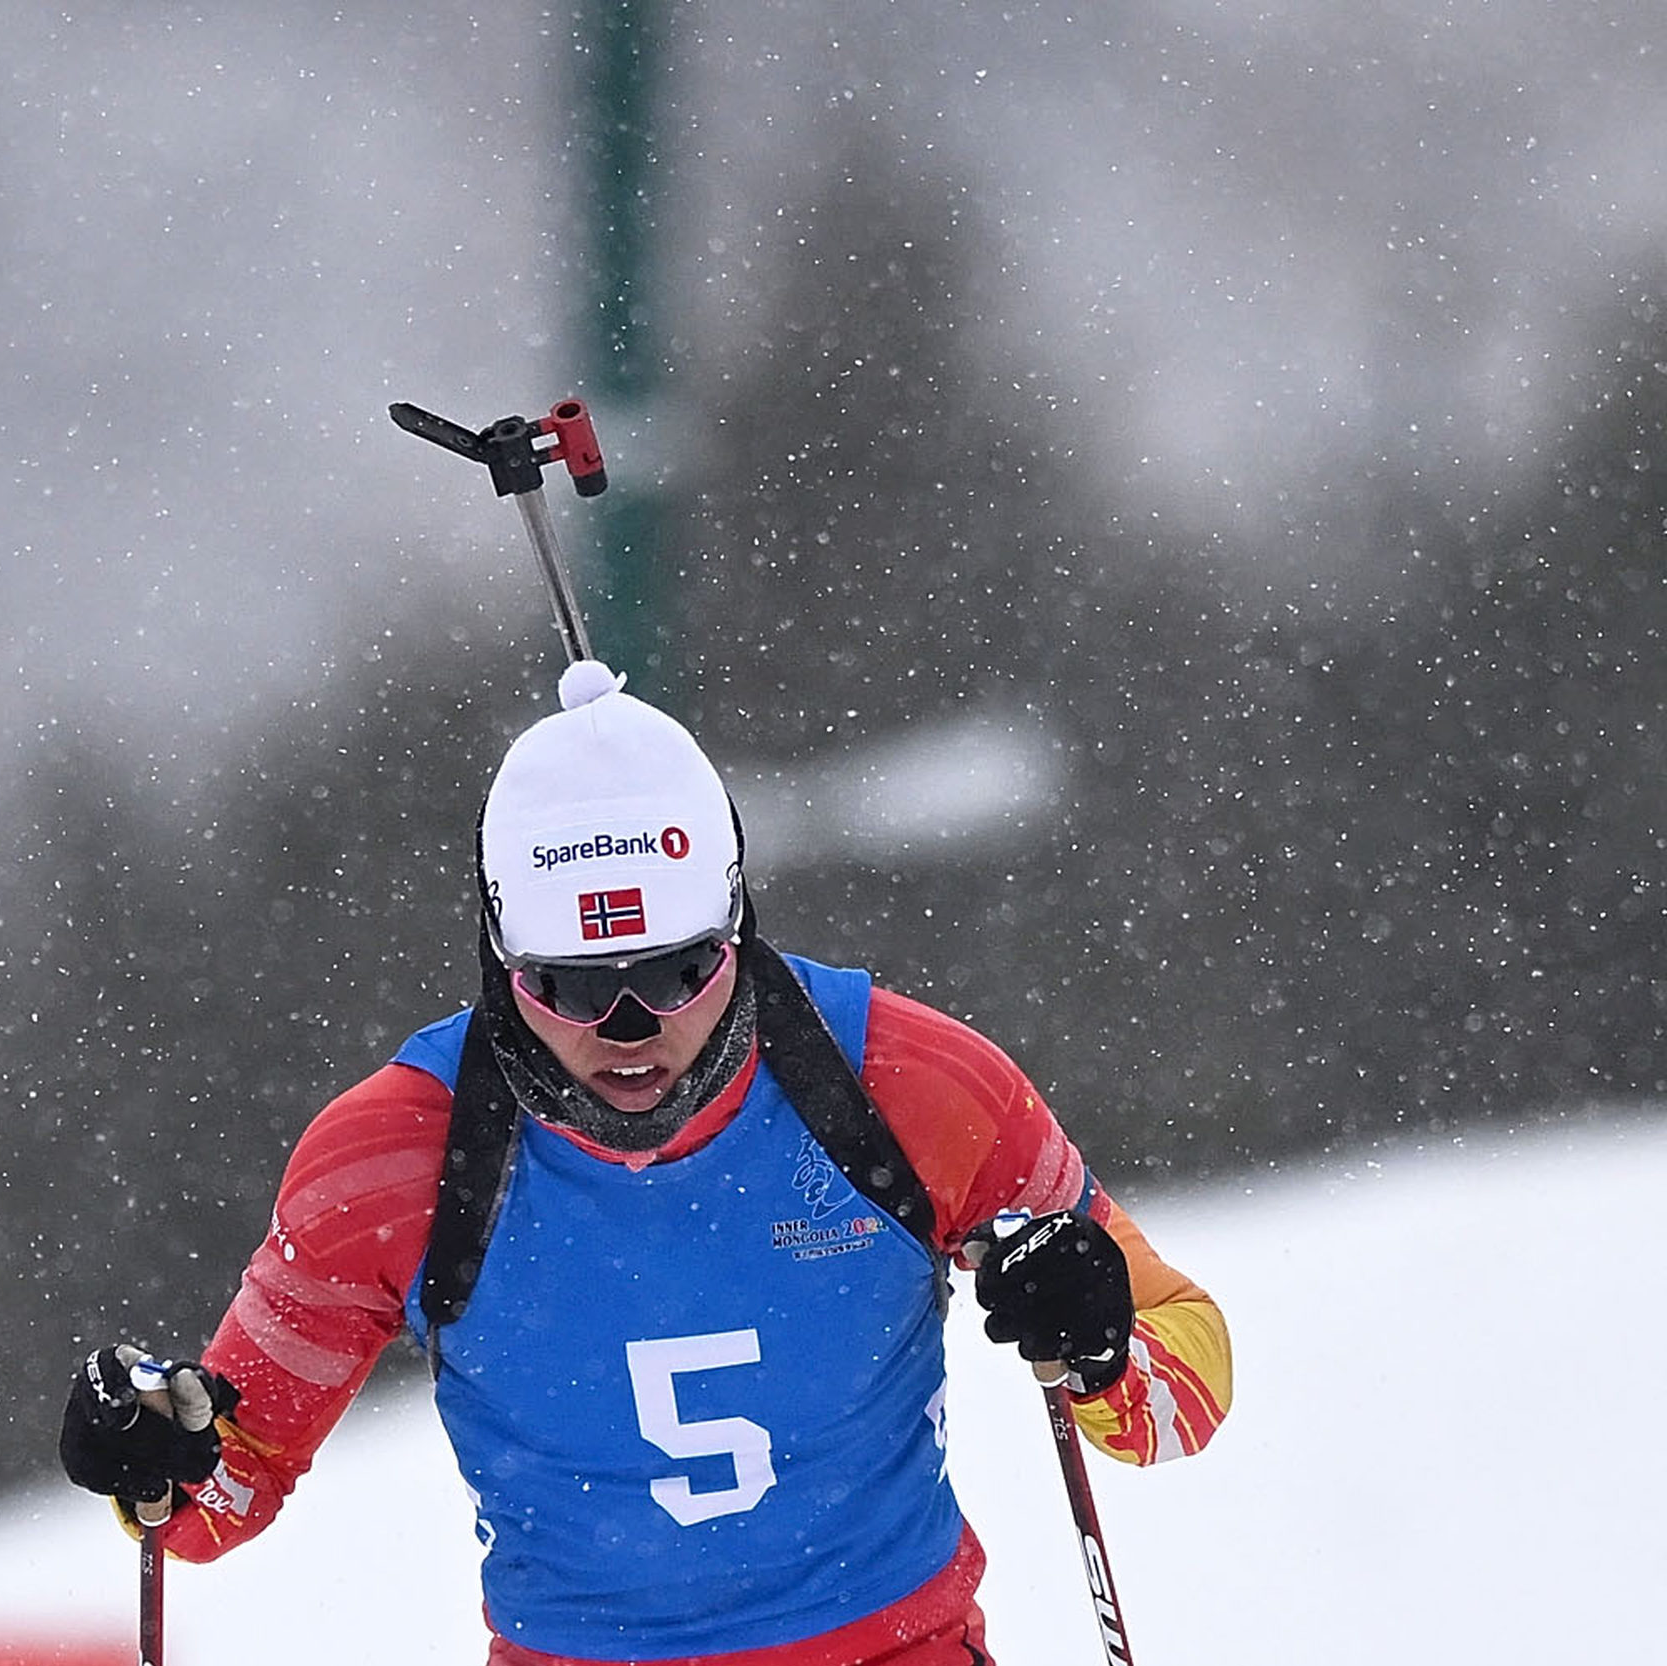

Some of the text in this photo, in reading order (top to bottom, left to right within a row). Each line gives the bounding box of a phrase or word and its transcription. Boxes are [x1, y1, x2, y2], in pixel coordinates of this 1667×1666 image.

[532, 831, 659, 871] SpareBank
[771, 1219, 809, 1234] INNER
[772, 1229, 839, 1248] MONGOLIA
[1000, 1212, 1073, 1274] REX
[86, 1350, 112, 1403] REX
[625, 1328, 777, 1527] 5
[1053, 1416, 1068, 1441] TCS
